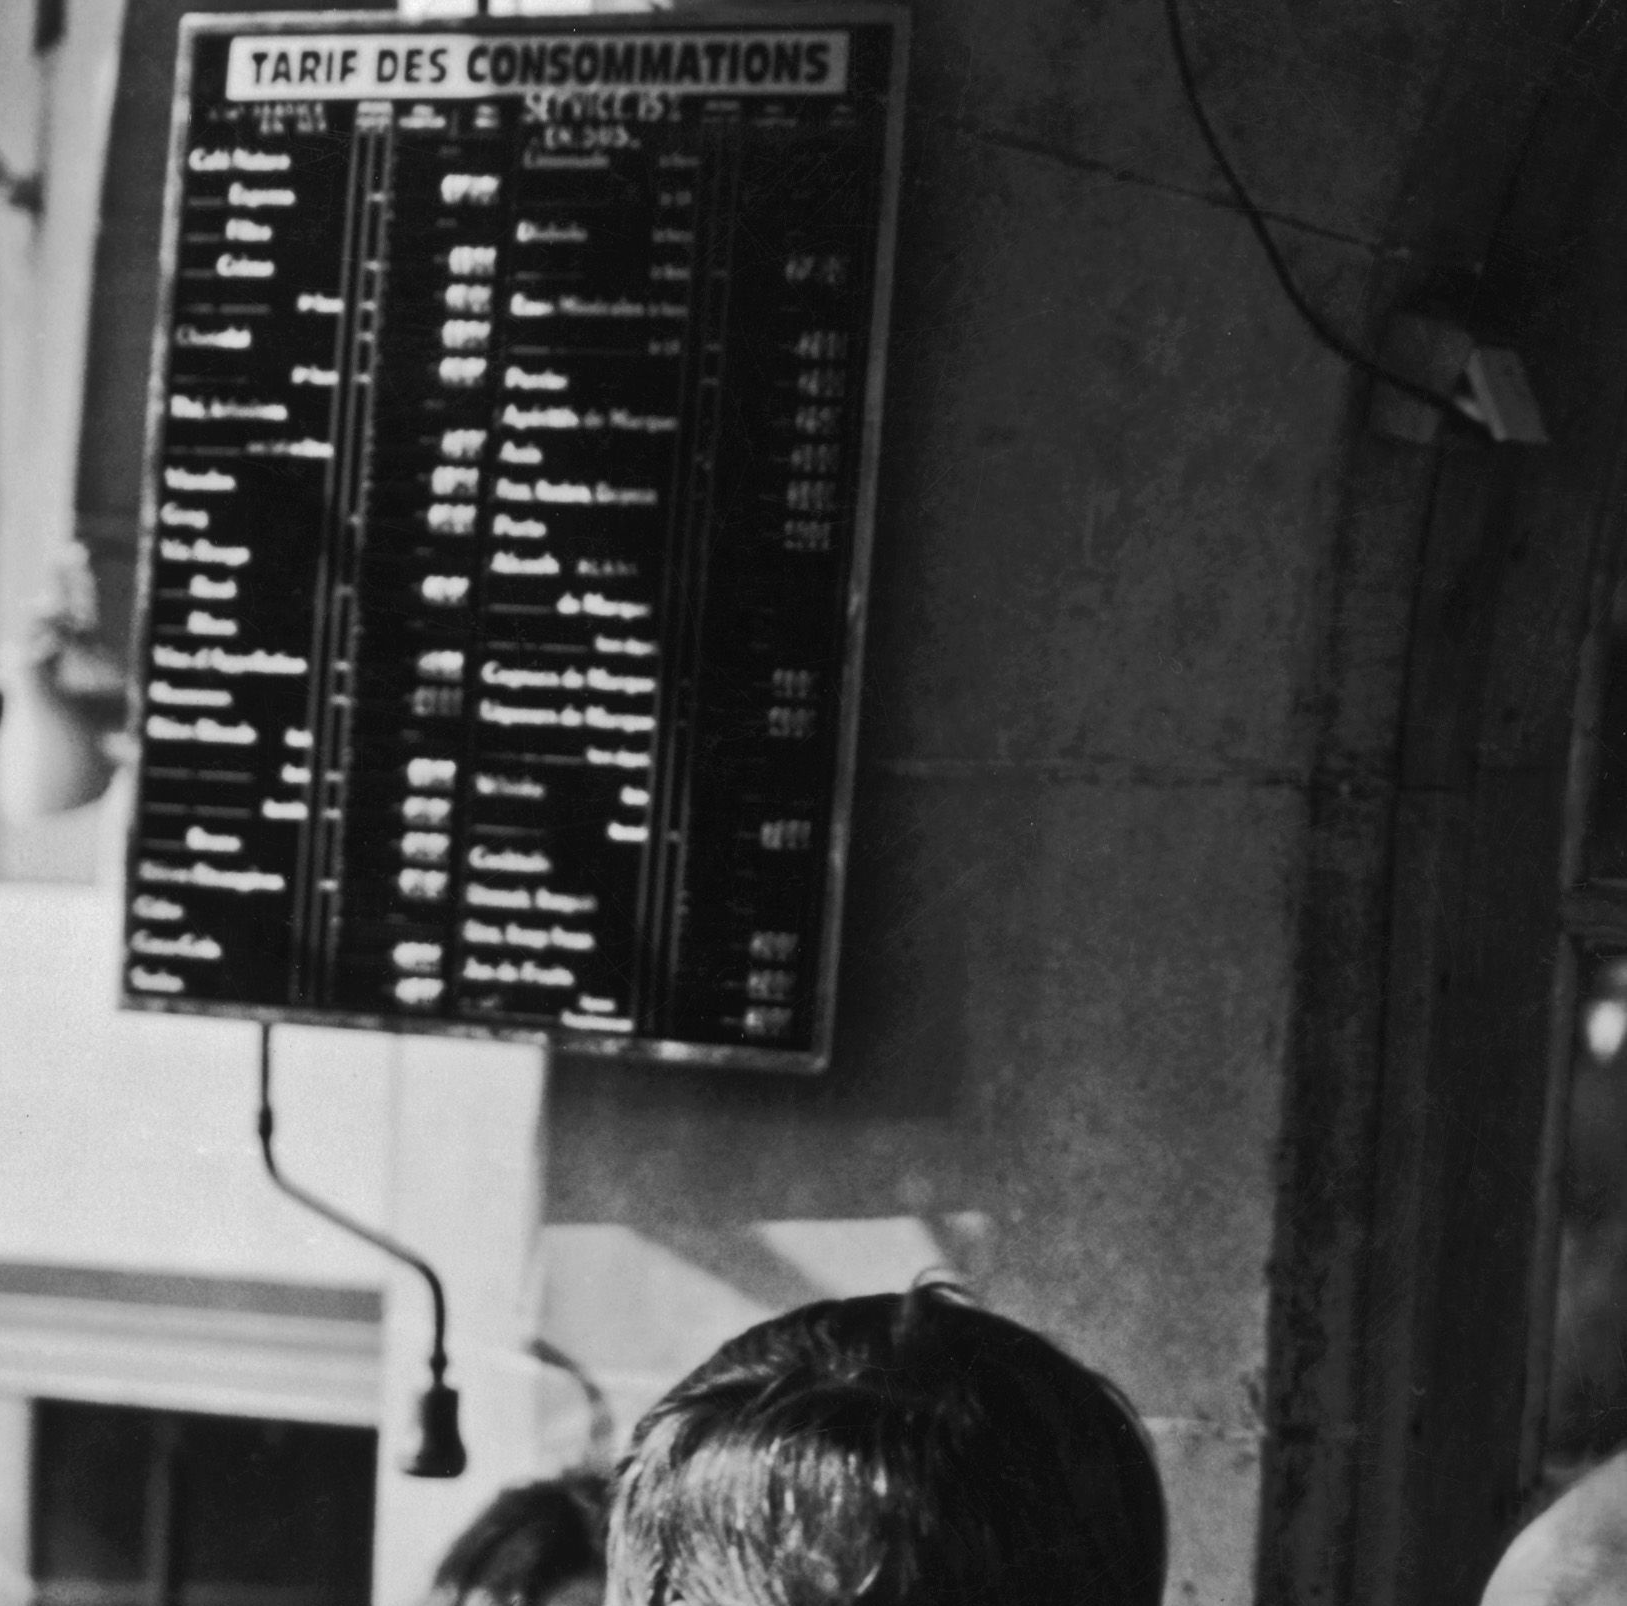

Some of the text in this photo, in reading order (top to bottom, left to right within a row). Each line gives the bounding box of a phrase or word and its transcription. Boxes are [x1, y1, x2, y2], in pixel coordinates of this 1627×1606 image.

[251, 41, 830, 87] TARIF DES CONSOMMATIONS
